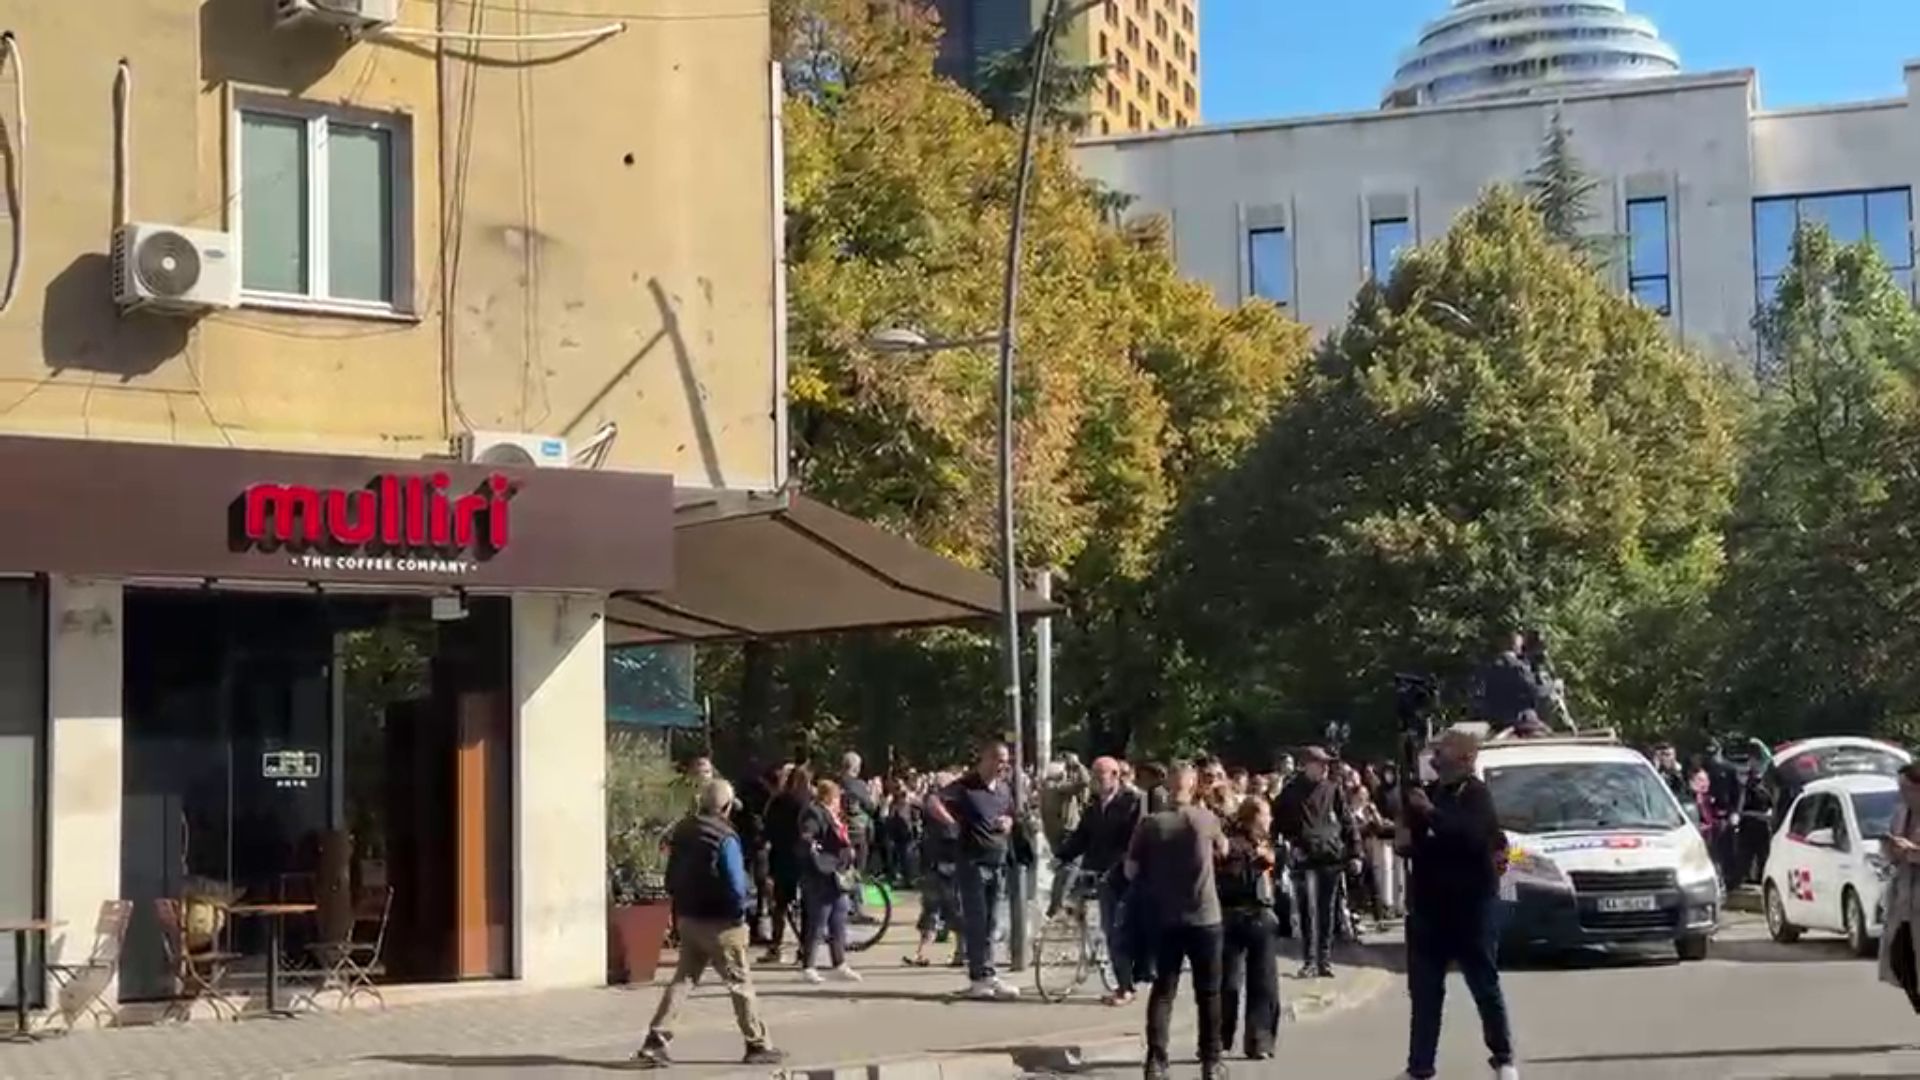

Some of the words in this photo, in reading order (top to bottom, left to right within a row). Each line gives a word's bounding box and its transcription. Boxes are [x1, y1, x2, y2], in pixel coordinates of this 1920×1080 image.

[244, 471, 510, 550] mulliri
[302, 555, 331, 568] THE
[336, 556, 394, 571] COFFEE
[397, 558, 468, 574] COMPANY
